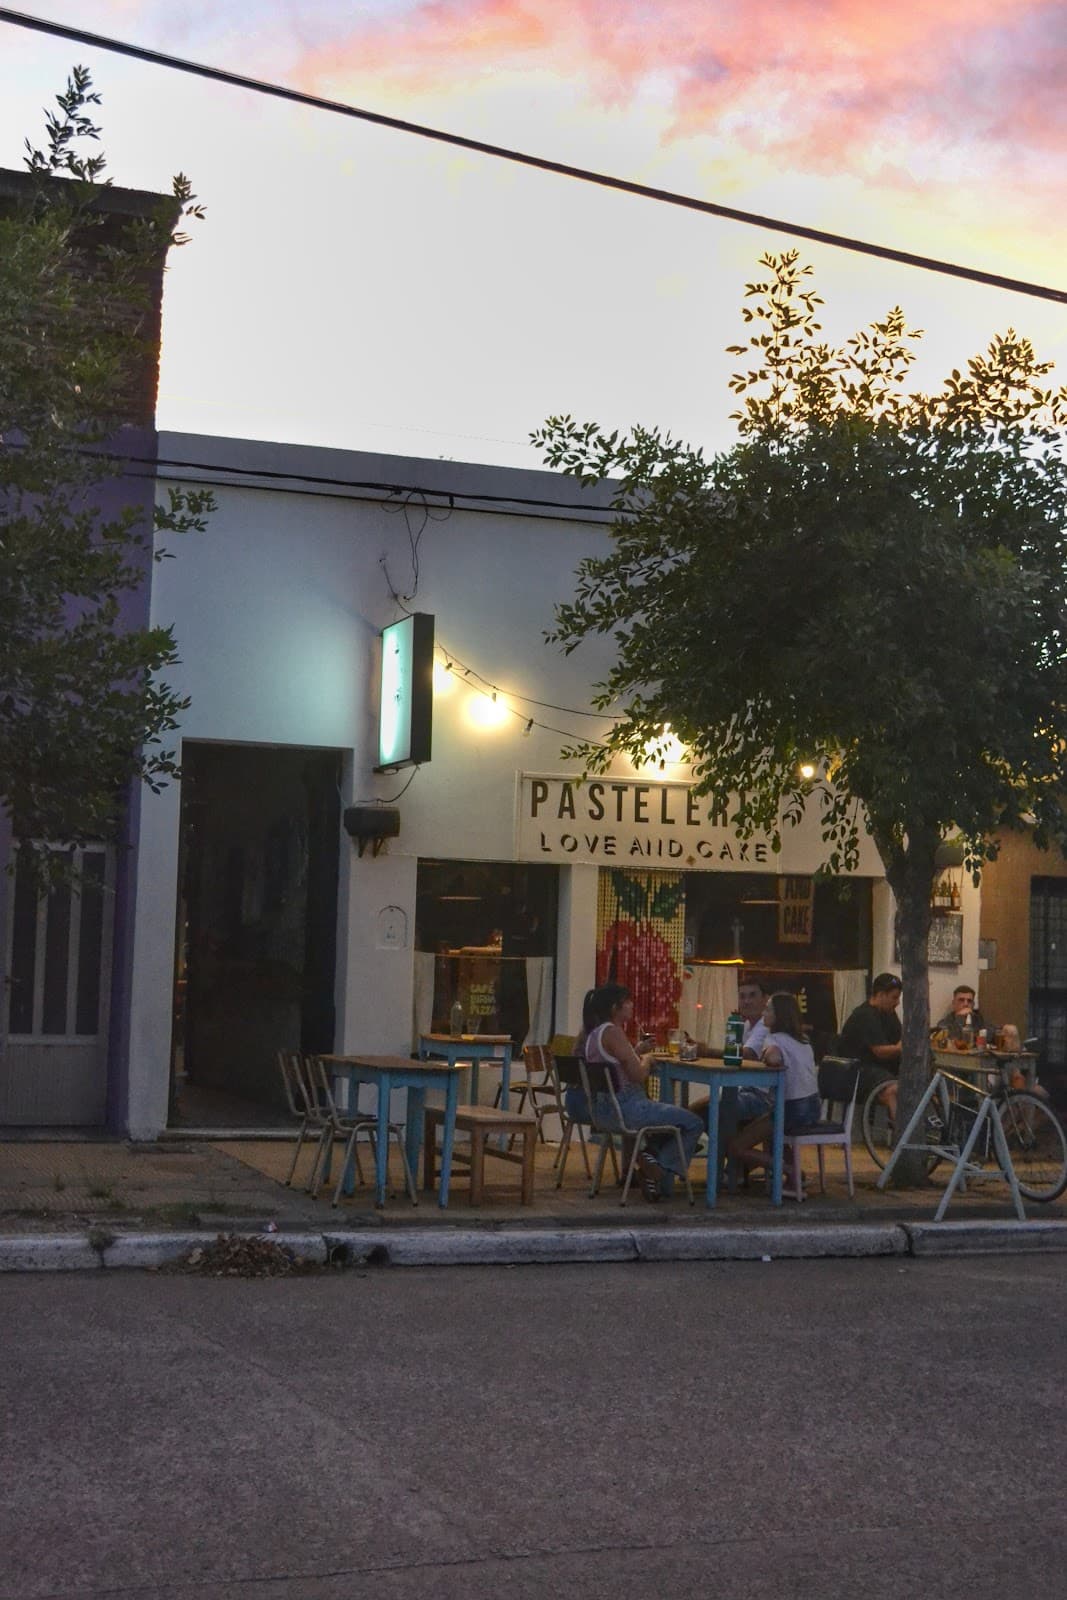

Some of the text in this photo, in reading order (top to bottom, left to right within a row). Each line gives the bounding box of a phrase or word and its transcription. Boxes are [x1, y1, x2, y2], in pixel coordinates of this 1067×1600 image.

[540, 831, 767, 863] LOVE AND CAKE
